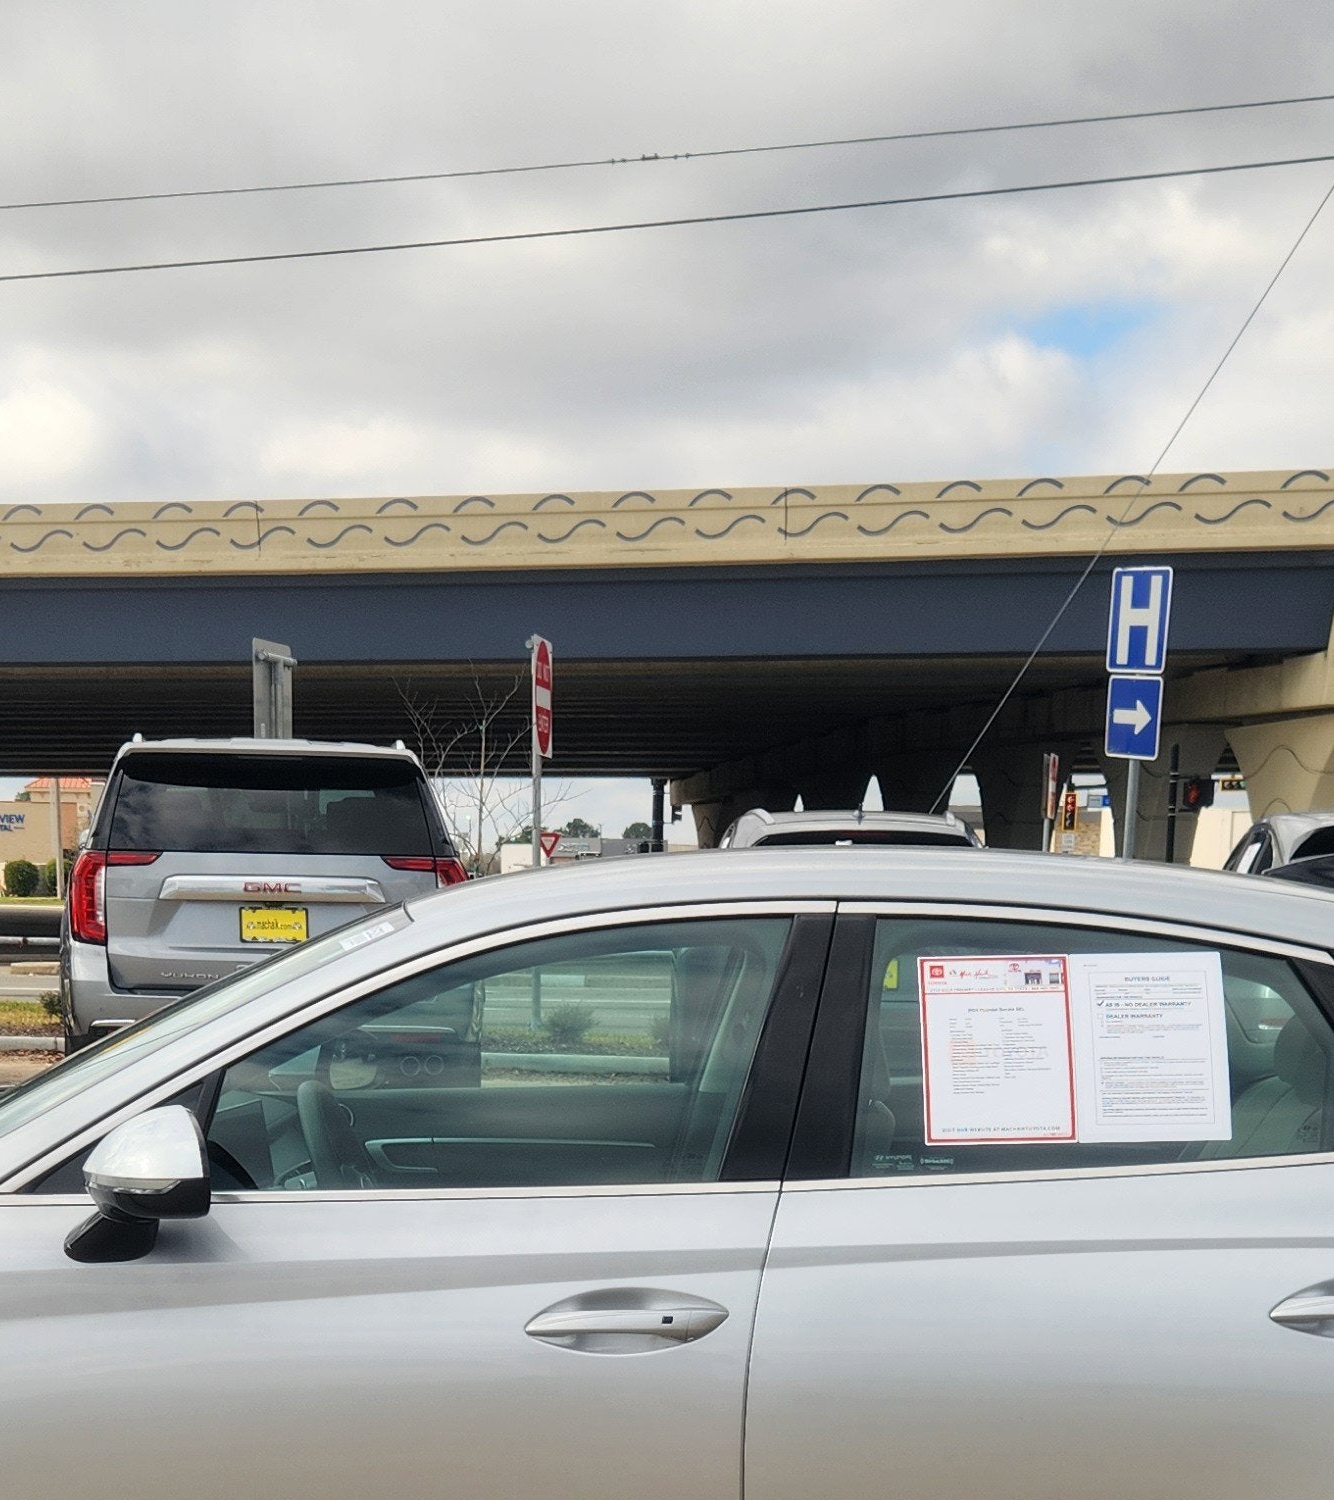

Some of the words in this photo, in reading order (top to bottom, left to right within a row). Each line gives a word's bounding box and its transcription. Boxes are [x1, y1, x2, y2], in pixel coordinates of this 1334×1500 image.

[1116, 575, 1163, 666] H
[243, 882, 302, 894] GMC
[160, 971, 220, 980] YUKON
